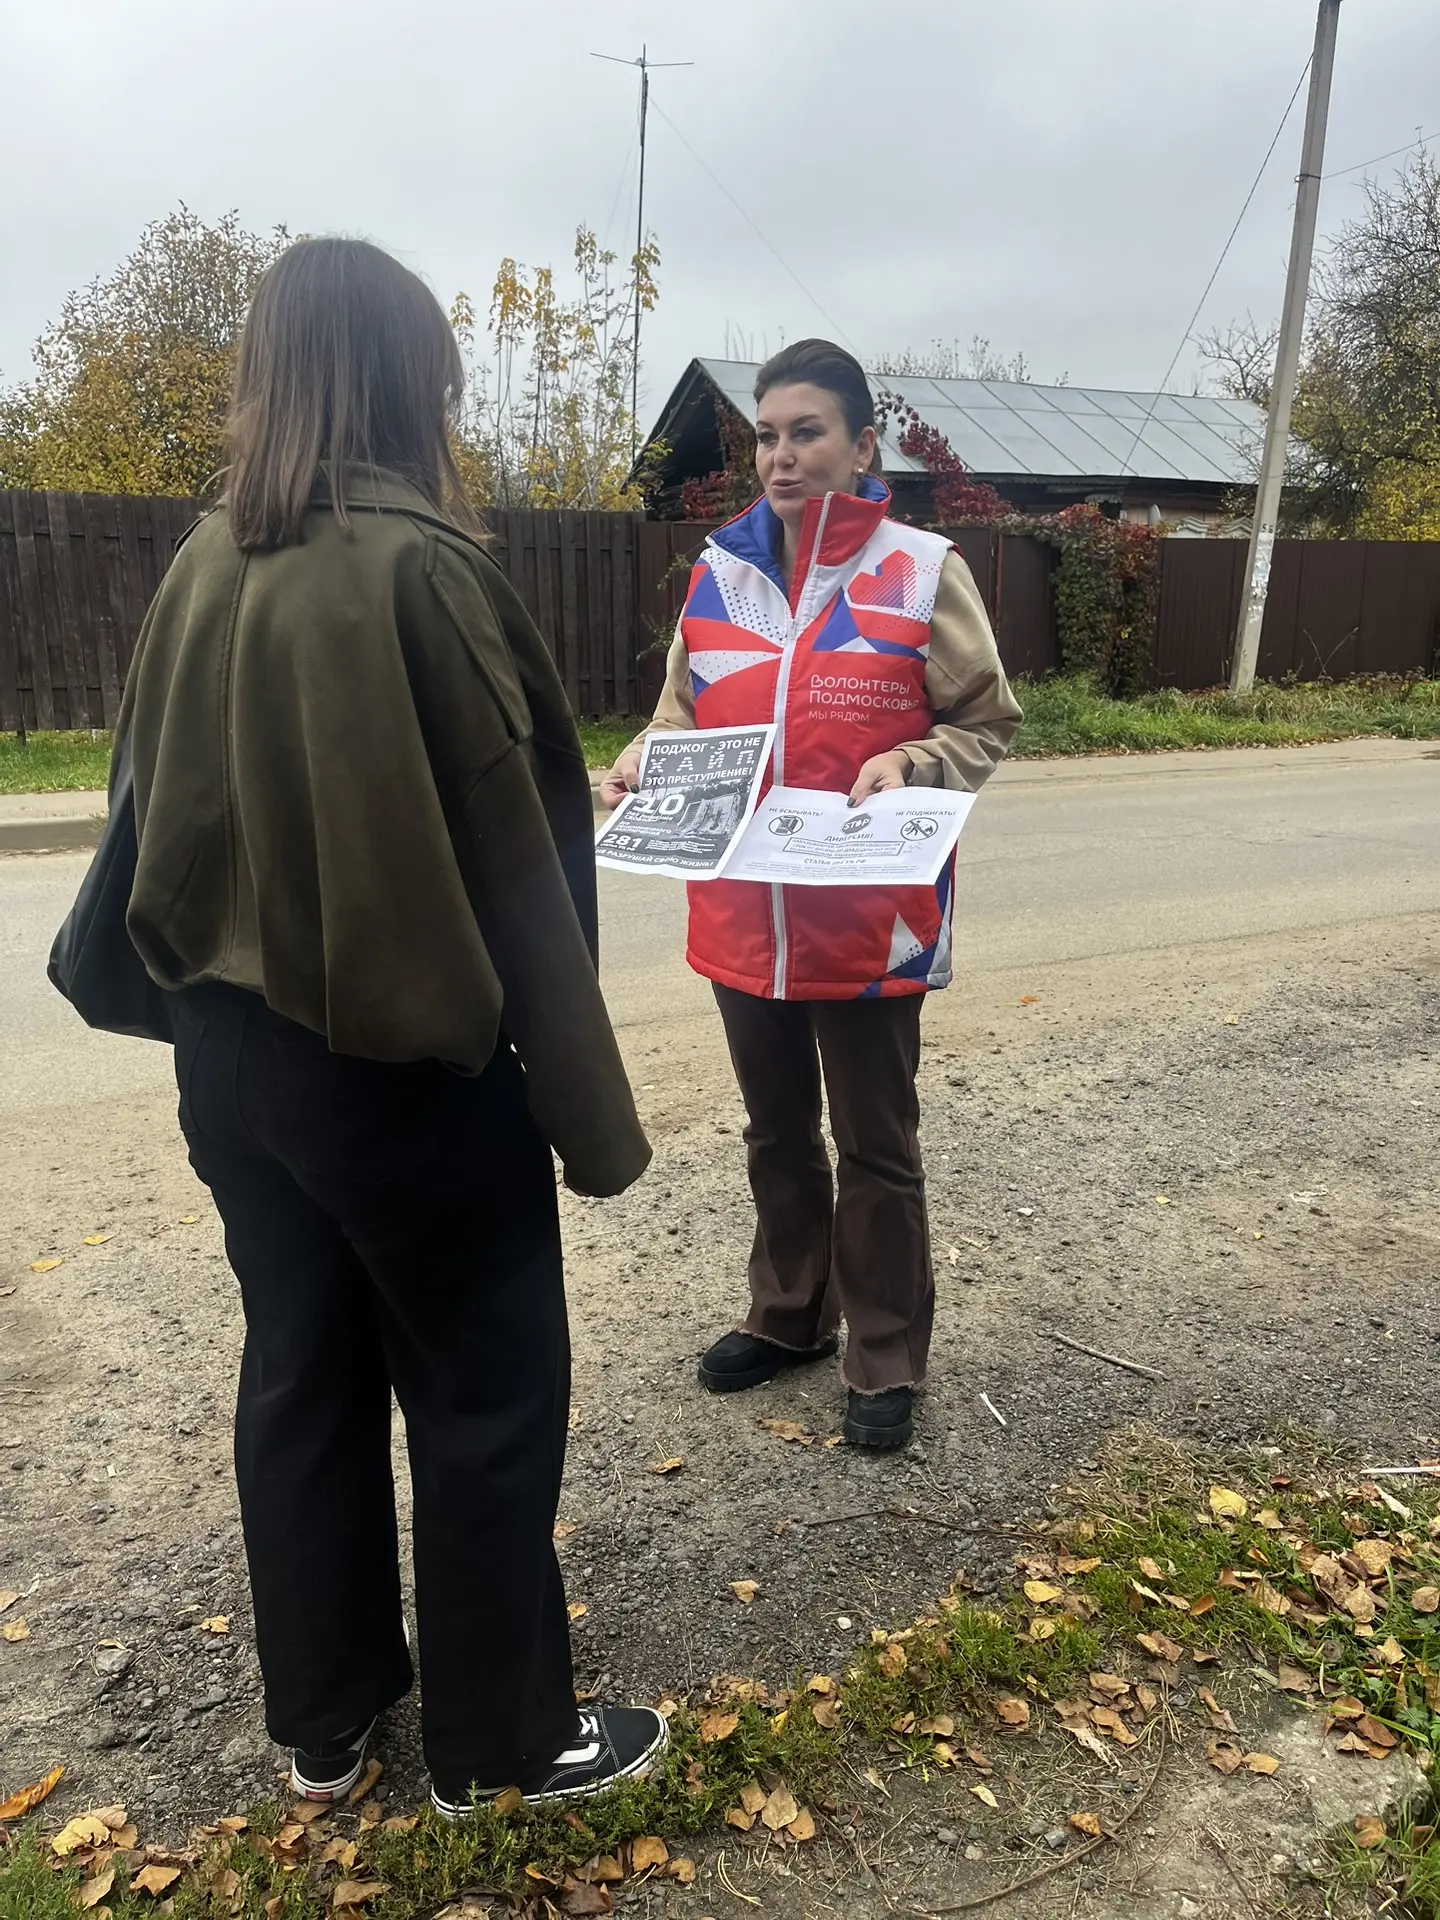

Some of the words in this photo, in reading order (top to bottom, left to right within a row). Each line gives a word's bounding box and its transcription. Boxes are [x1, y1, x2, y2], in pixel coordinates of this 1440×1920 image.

[810, 674, 911, 695] ВОЛОНТЕРЫ
[808, 710, 828, 720] МЫ
[830, 710, 870, 723] РЯДОМ
[651, 742, 708, 756] ПОДЖОГ
[717, 739, 743, 751] ЭТО
[743, 737, 762, 748] НЕ
[644, 776, 667, 787] ЭТО
[666, 767, 753, 785] ПРЕСТУПЛЕНИЕ!
[631, 793, 686, 816] 10
[778, 808, 824, 817] ВСКРЫВАТЬ!
[602, 833, 643, 848] 281
[824, 833, 874, 843] ДИВЕРСИЯ!
[606, 849, 653, 863] РАЗРУШАЙ
[679, 858, 714, 867] ЖИЗНЬ!
